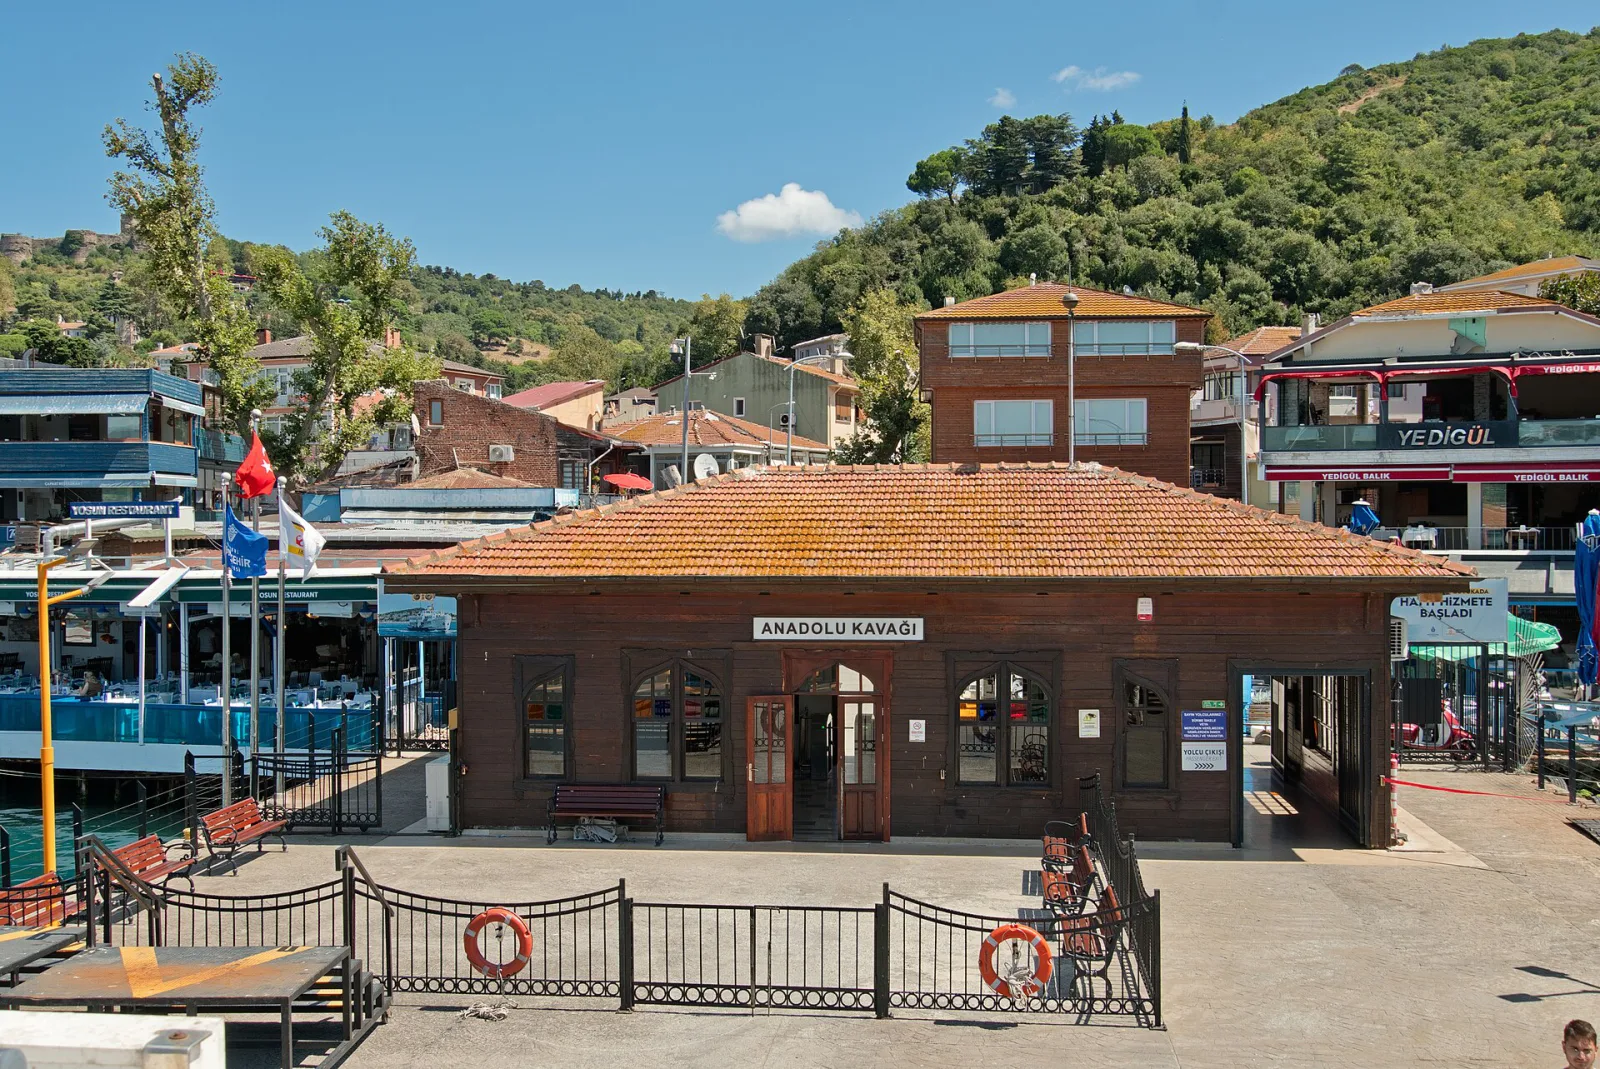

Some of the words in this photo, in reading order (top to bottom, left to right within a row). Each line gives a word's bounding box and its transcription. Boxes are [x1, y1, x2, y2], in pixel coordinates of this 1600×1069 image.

[1543, 365, 1586, 373] YEDİGÜL
[1398, 425, 1496, 446] YEDİGÜL
[1322, 472, 1360, 480] YEDİGÜL
[1514, 473, 1557, 481] YEDİGÜL
[71, 505, 107, 516] YOSUN
[108, 504, 174, 516] RESTAURANT
[284, 591, 319, 599] ESTAURANT
[1420, 608, 1473, 620] BAŞLADI
[761, 622, 847, 635] ANADOLU
[852, 620, 917, 636] KAVAĞI
